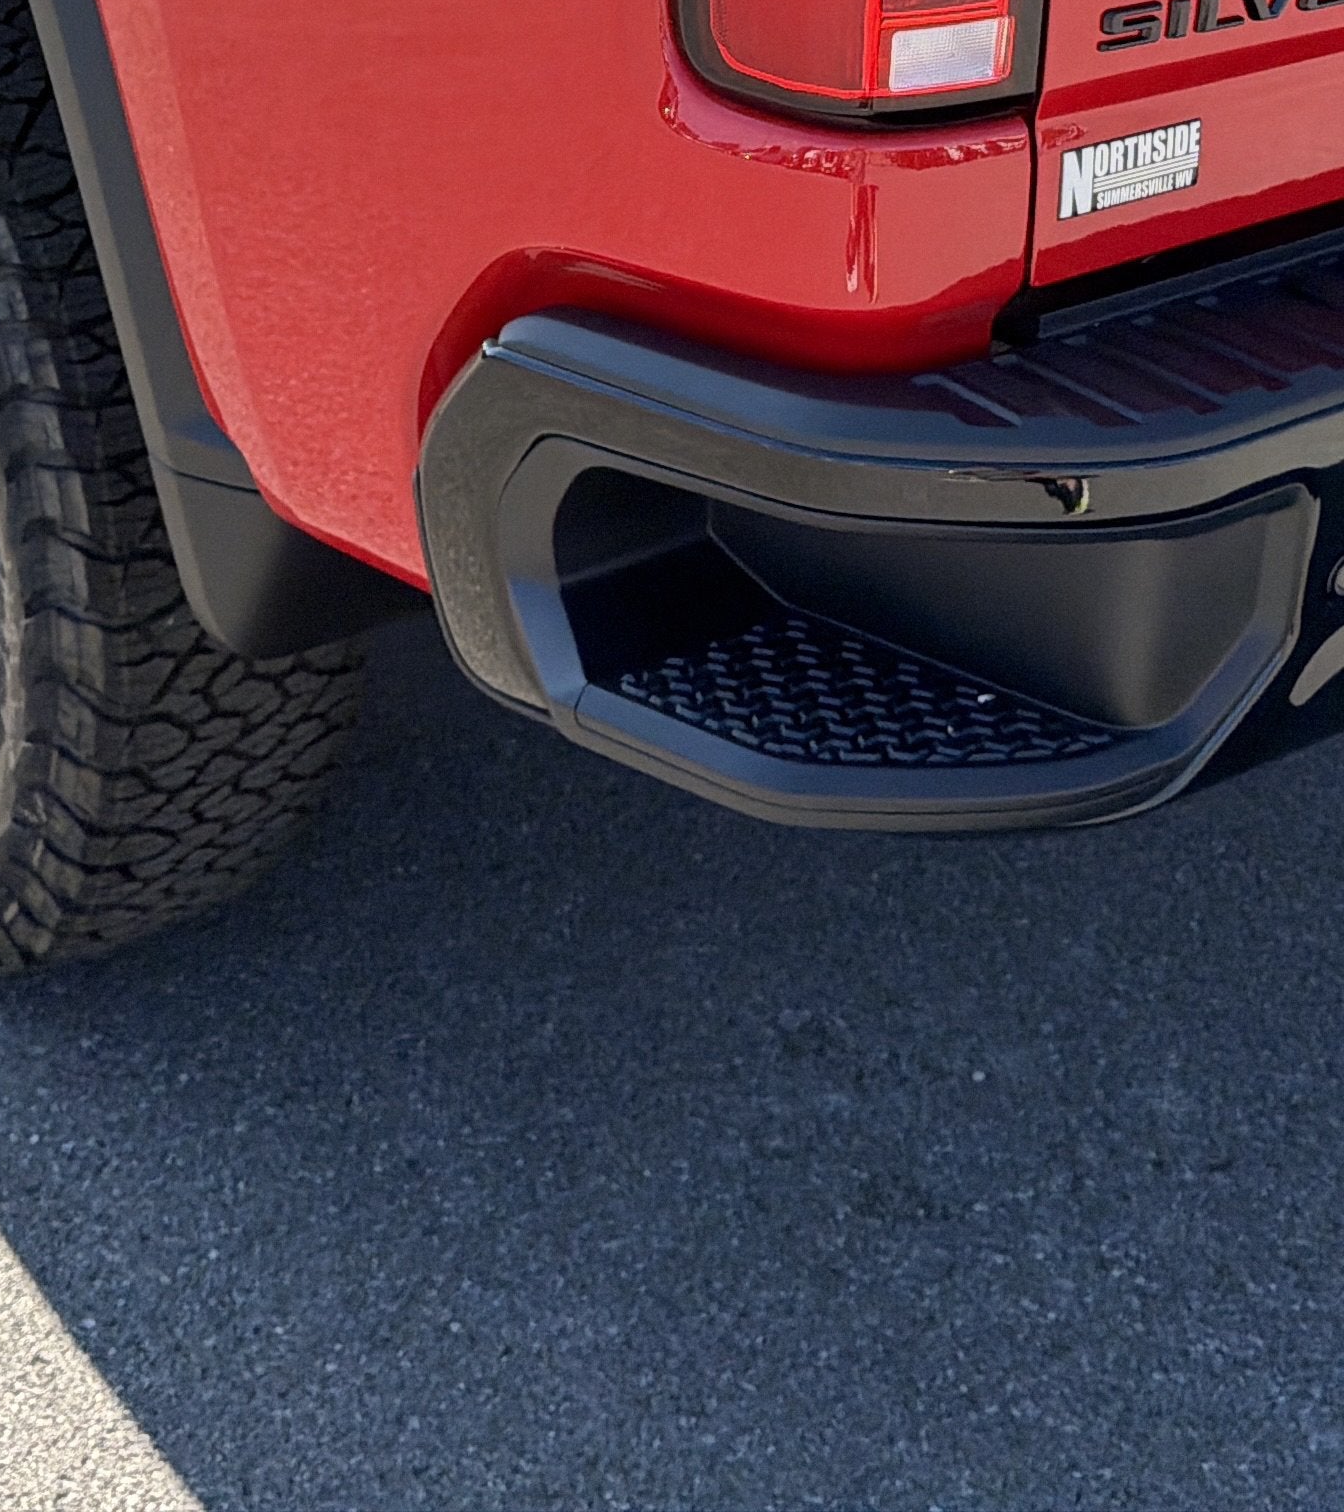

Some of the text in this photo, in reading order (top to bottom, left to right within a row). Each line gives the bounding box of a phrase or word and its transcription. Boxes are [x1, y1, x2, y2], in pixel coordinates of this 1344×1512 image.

[1059, 120, 1201, 219] NORTHSIDE
[1096, 169, 1194, 210] SUMMERSVILLE WV
